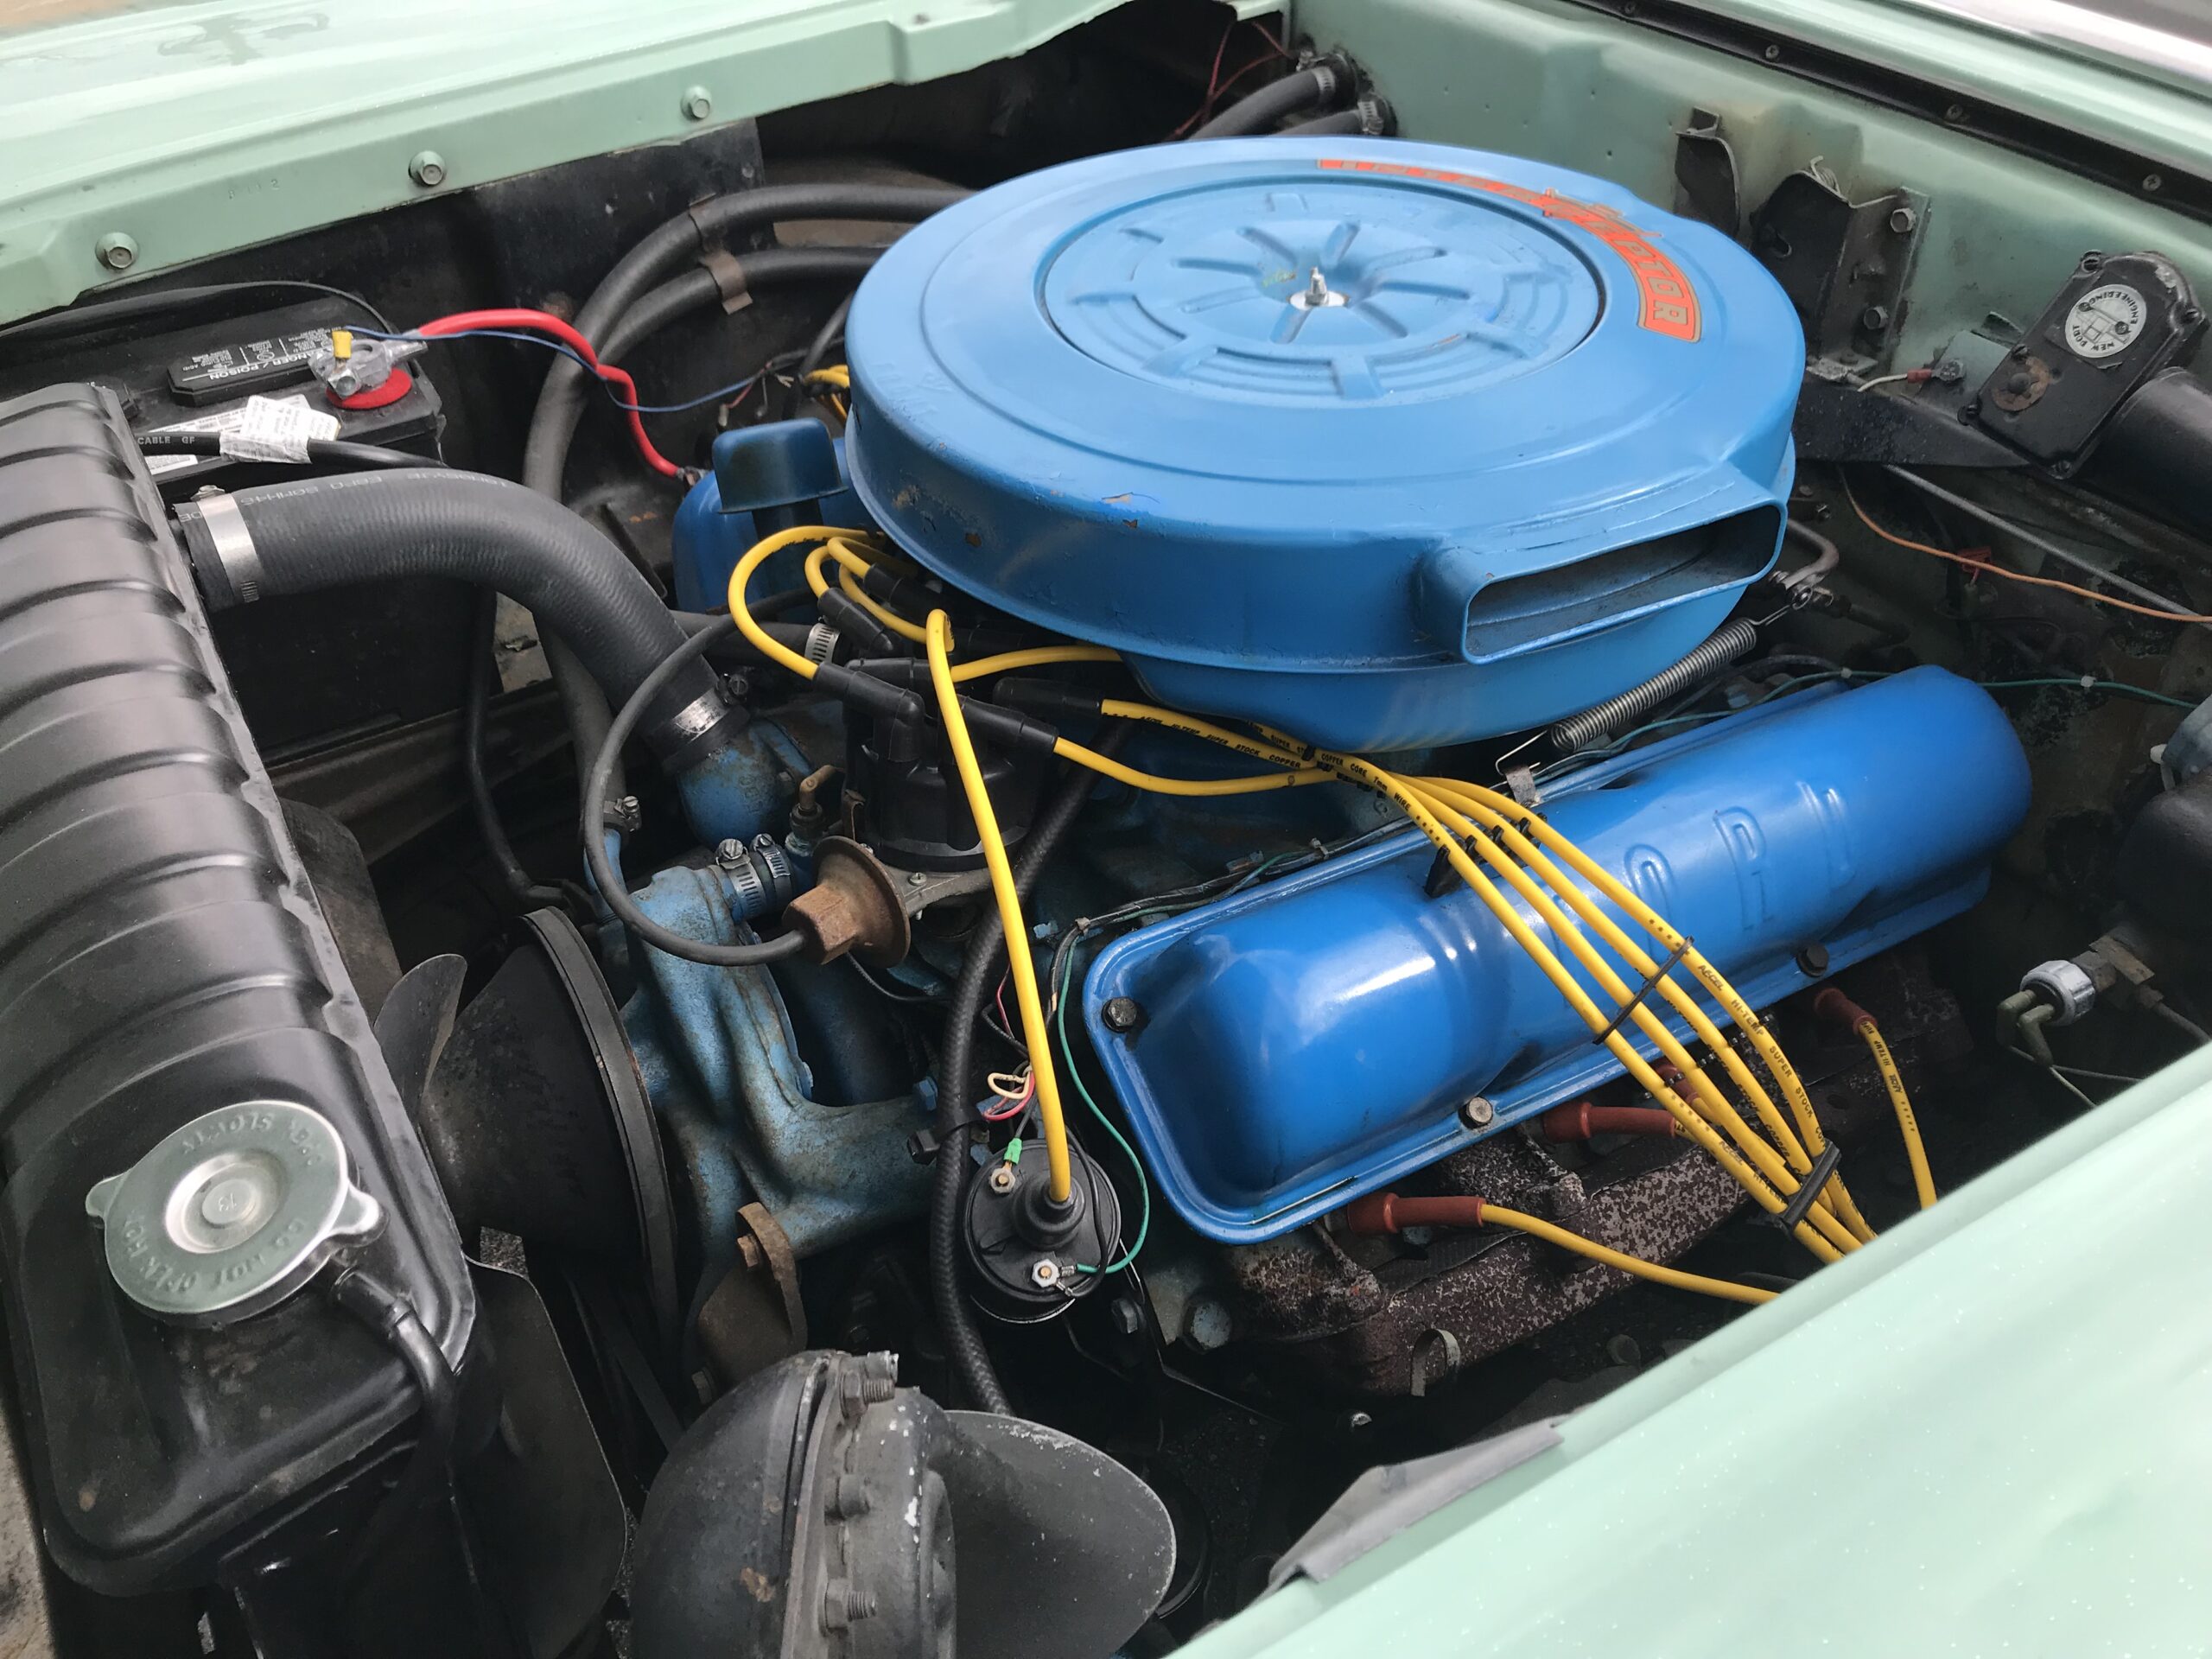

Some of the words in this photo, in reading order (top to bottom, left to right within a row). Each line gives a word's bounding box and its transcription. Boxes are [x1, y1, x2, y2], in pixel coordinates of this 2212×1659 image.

[1340, 158, 1689, 326] INTERCEPTOR
[2091, 341, 2115, 351] NEW
[209, 364, 259, 380] POISON
[137, 435, 171, 446] CABLE
[181, 435, 196, 445] GF
[1207, 734, 1229, 746] SUPER
[1236, 743, 1260, 756] STOCK
[1268, 753, 1301, 768] COPPER
[1270, 734, 1290, 748] SUPER
[1320, 753, 1344, 767] COPPER
[1350, 762, 1368, 778] CORE
[1393, 792, 1412, 811] WIRE
[1698, 964, 1724, 992] ACCEL
[1731, 999, 1764, 1036] HI-TEMP
[1769, 1046, 1793, 1077] SUPER
[1796, 1087, 1813, 1118] STOCK
[1873, 1040, 1891, 1066] HI-TEMP
[217, 1192, 238, 1212] 13
